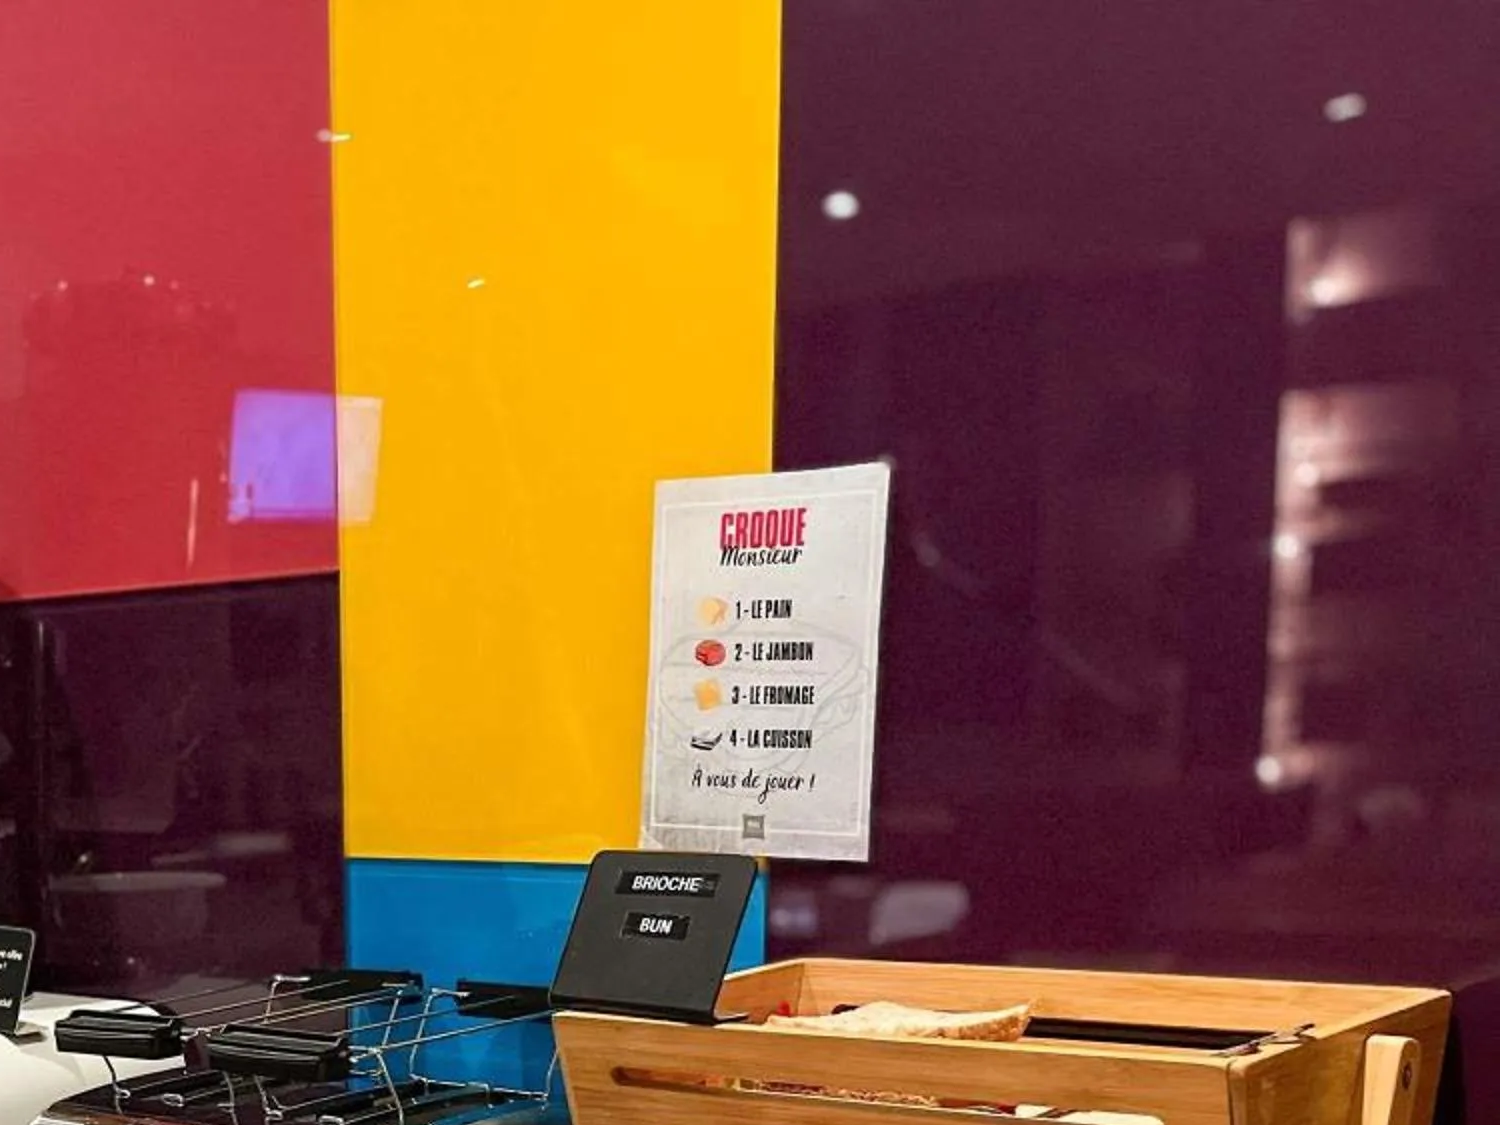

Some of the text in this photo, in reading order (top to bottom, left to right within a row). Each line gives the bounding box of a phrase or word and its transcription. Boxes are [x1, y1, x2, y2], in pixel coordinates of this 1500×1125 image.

[719, 508, 807, 549] CROQUE
[720, 545, 803, 566] Monsieur
[735, 600, 741, 619] 1
[751, 600, 762, 618] LE
[765, 600, 793, 618] PAIN
[734, 643, 743, 661] 2
[752, 642, 763, 660] LE
[765, 642, 814, 660] JAMBON
[731, 685, 740, 704] 3
[749, 685, 761, 704] LE
[763, 685, 815, 704] FROMAGE
[730, 729, 738, 747] 4
[747, 729, 760, 748] LA
[763, 729, 813, 748] CUISSON
[707, 774, 736, 788] vous
[741, 767, 761, 788] de
[757, 773, 805, 804] jouer
[631, 874, 702, 892] BRIOCHE
[638, 917, 673, 934] BUN
